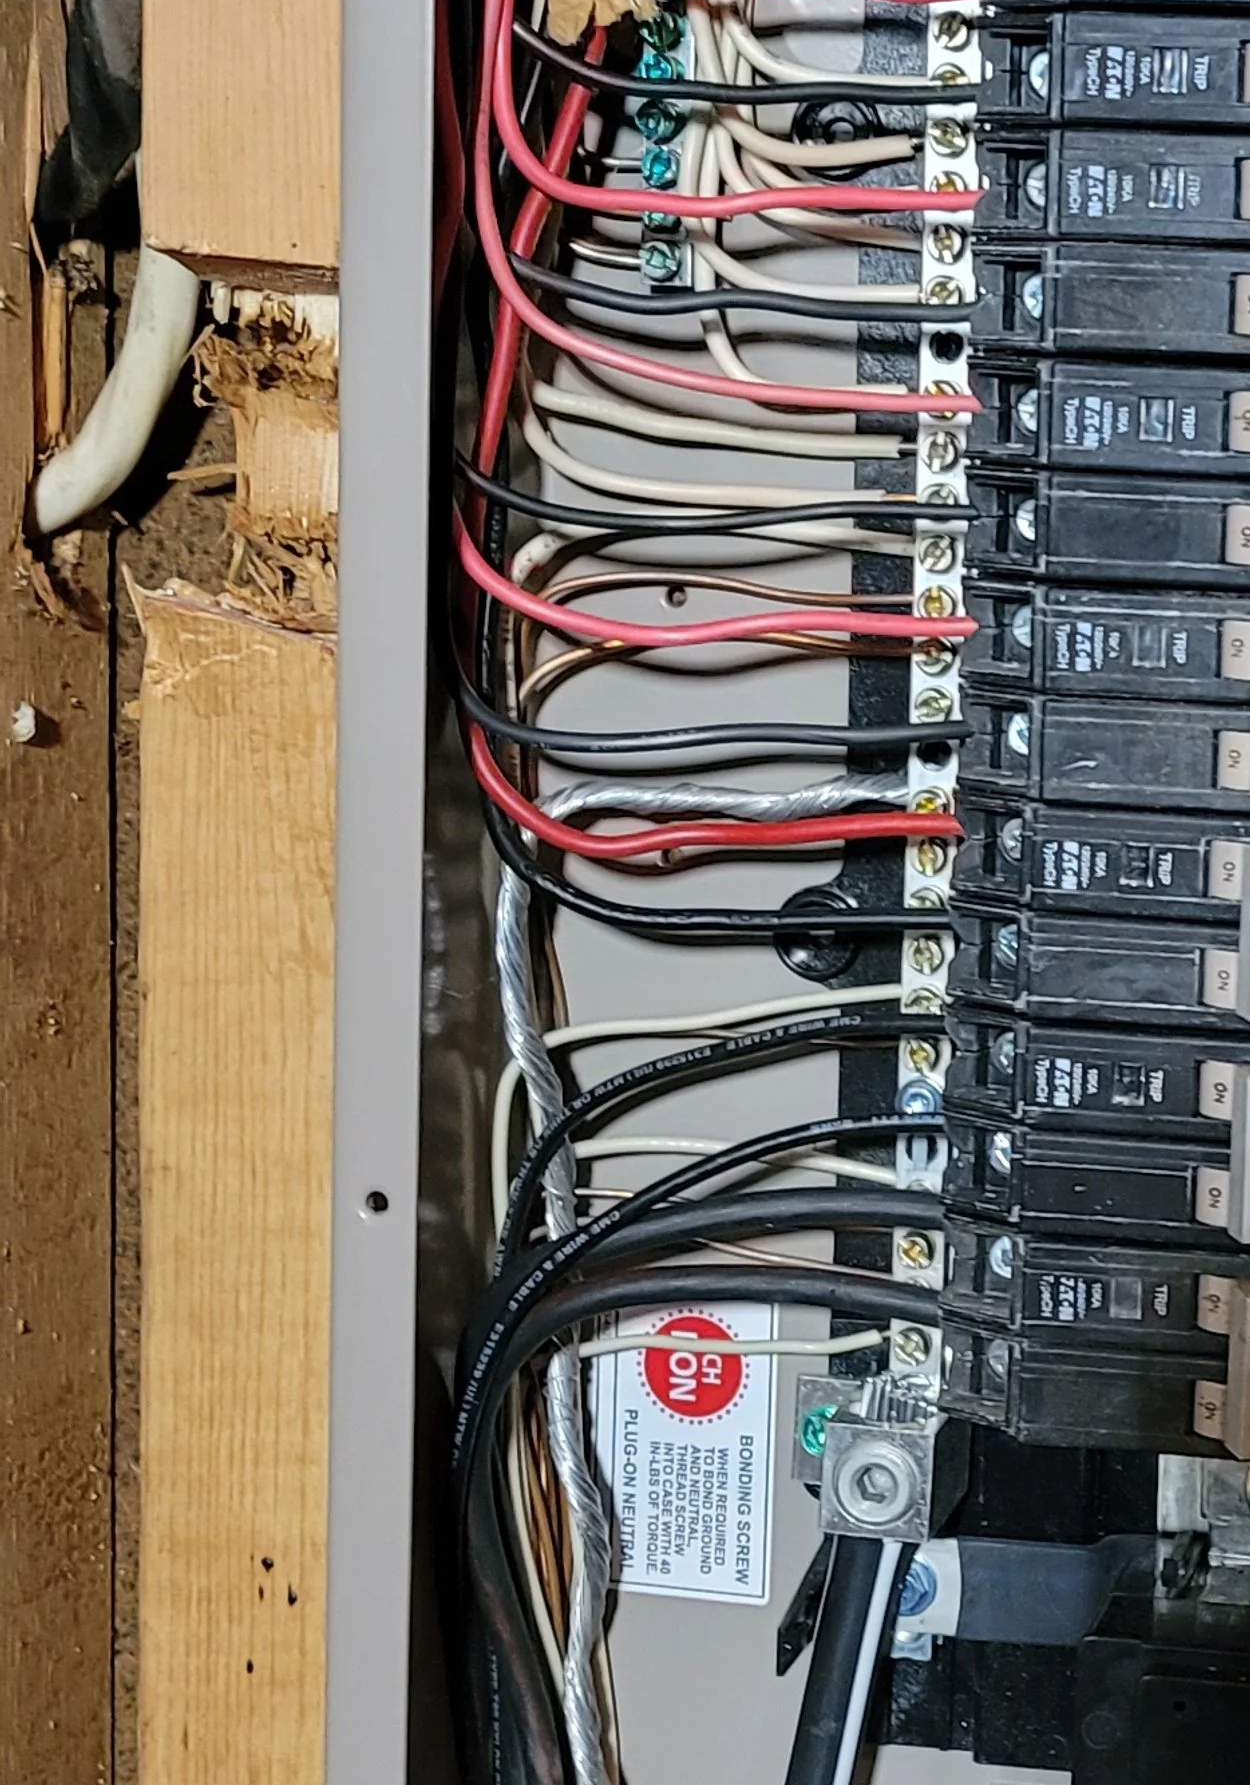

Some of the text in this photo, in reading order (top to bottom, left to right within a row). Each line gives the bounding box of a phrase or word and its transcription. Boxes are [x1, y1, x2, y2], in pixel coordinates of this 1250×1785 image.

[1195, 55, 1210, 91] TRIP
[1180, 406, 1196, 439] TRIP
[1172, 631, 1188, 664] TRIP
[1232, 638, 1244, 657] ON
[1157, 851, 1172, 885] TRIP
[1223, 862, 1235, 883] ON
[1217, 970, 1230, 992] ON
[1214, 1082, 1227, 1105] ON
[1209, 1187, 1221, 1208] ON
[1153, 1284, 1168, 1315] TRIP
[623, 1409, 639, 1487] PLUG-ON
[646, 1441, 661, 1577] IN-LBS OF TORQUE.
[659, 1443, 675, 1575] INTO CASE WITH 40
[673, 1444, 688, 1558] THREAD SCREW
[686, 1444, 702, 1549] AND NEUTRAL,
[700, 1447, 716, 1575] TO BOND GROUND
[714, 1448, 730, 1566] WHEN REQUIRED
[735, 1435, 754, 1586] BONDING SCREW
